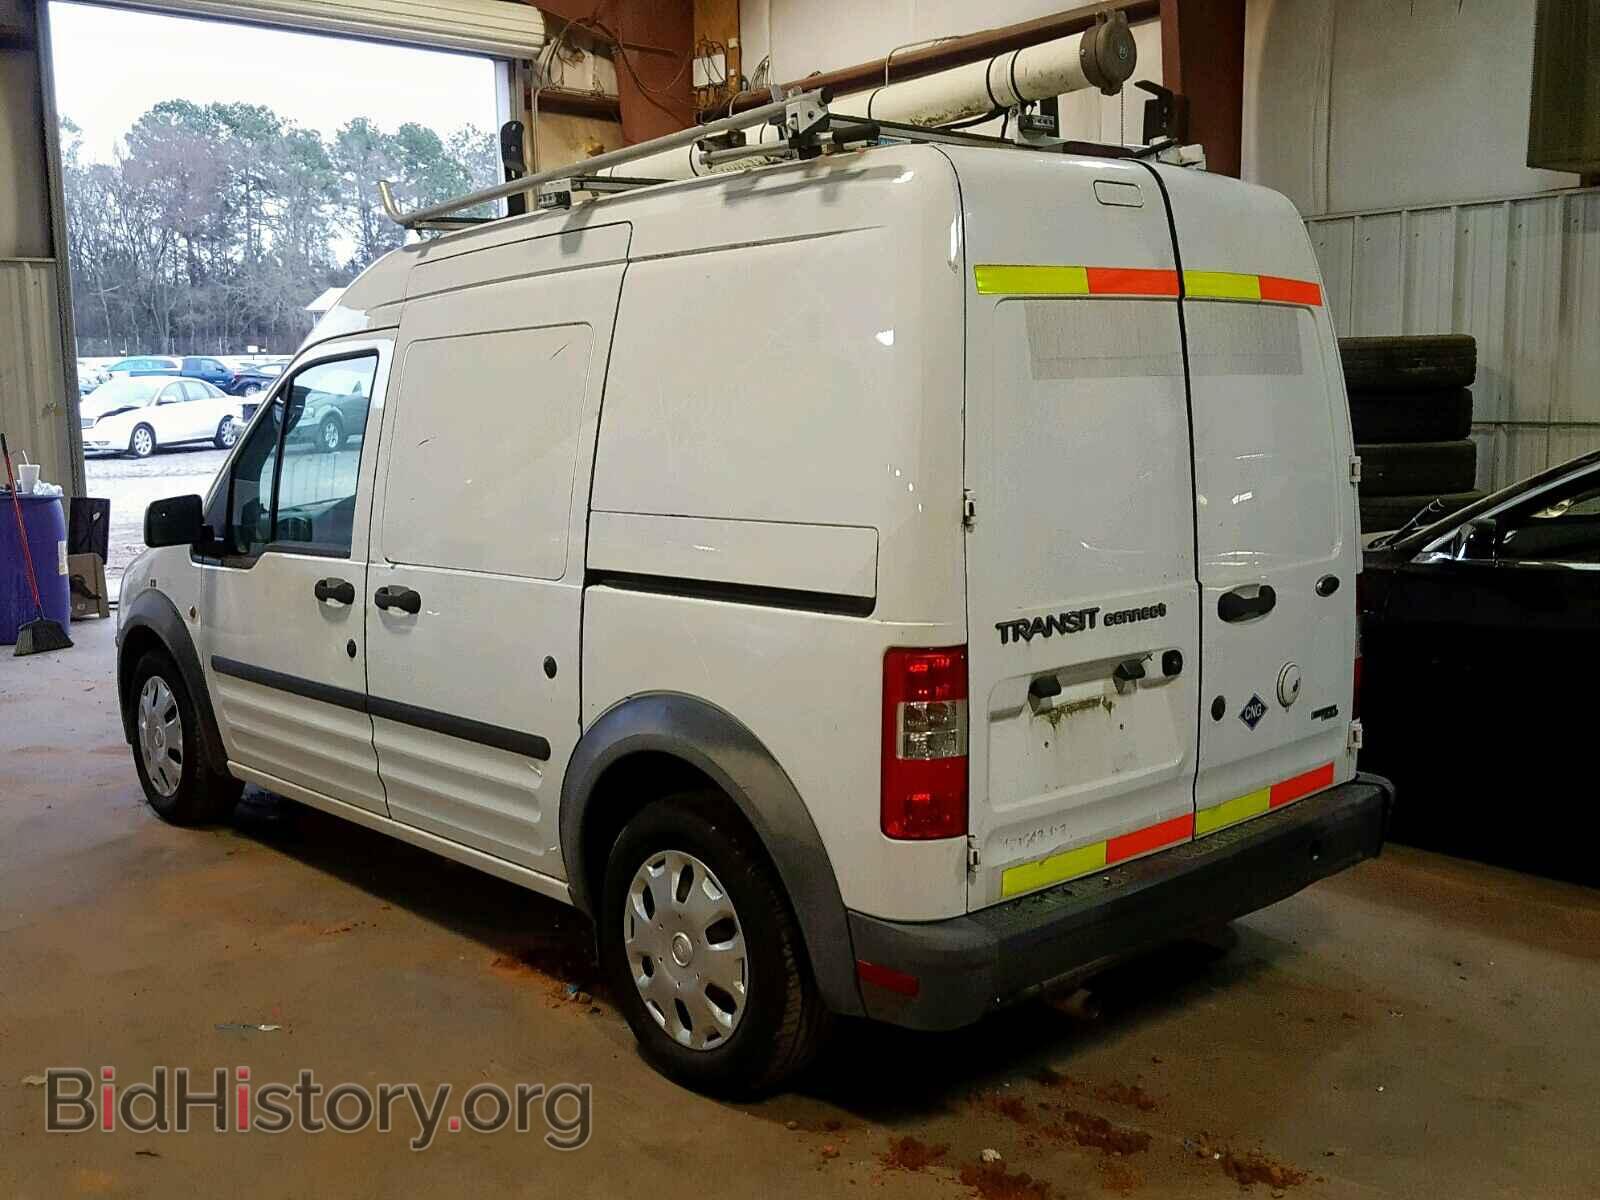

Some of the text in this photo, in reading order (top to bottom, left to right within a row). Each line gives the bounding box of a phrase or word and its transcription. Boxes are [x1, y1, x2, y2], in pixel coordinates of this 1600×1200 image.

[995, 603, 1167, 645] TRANSIT connect
[1244, 703, 1262, 720] CNG
